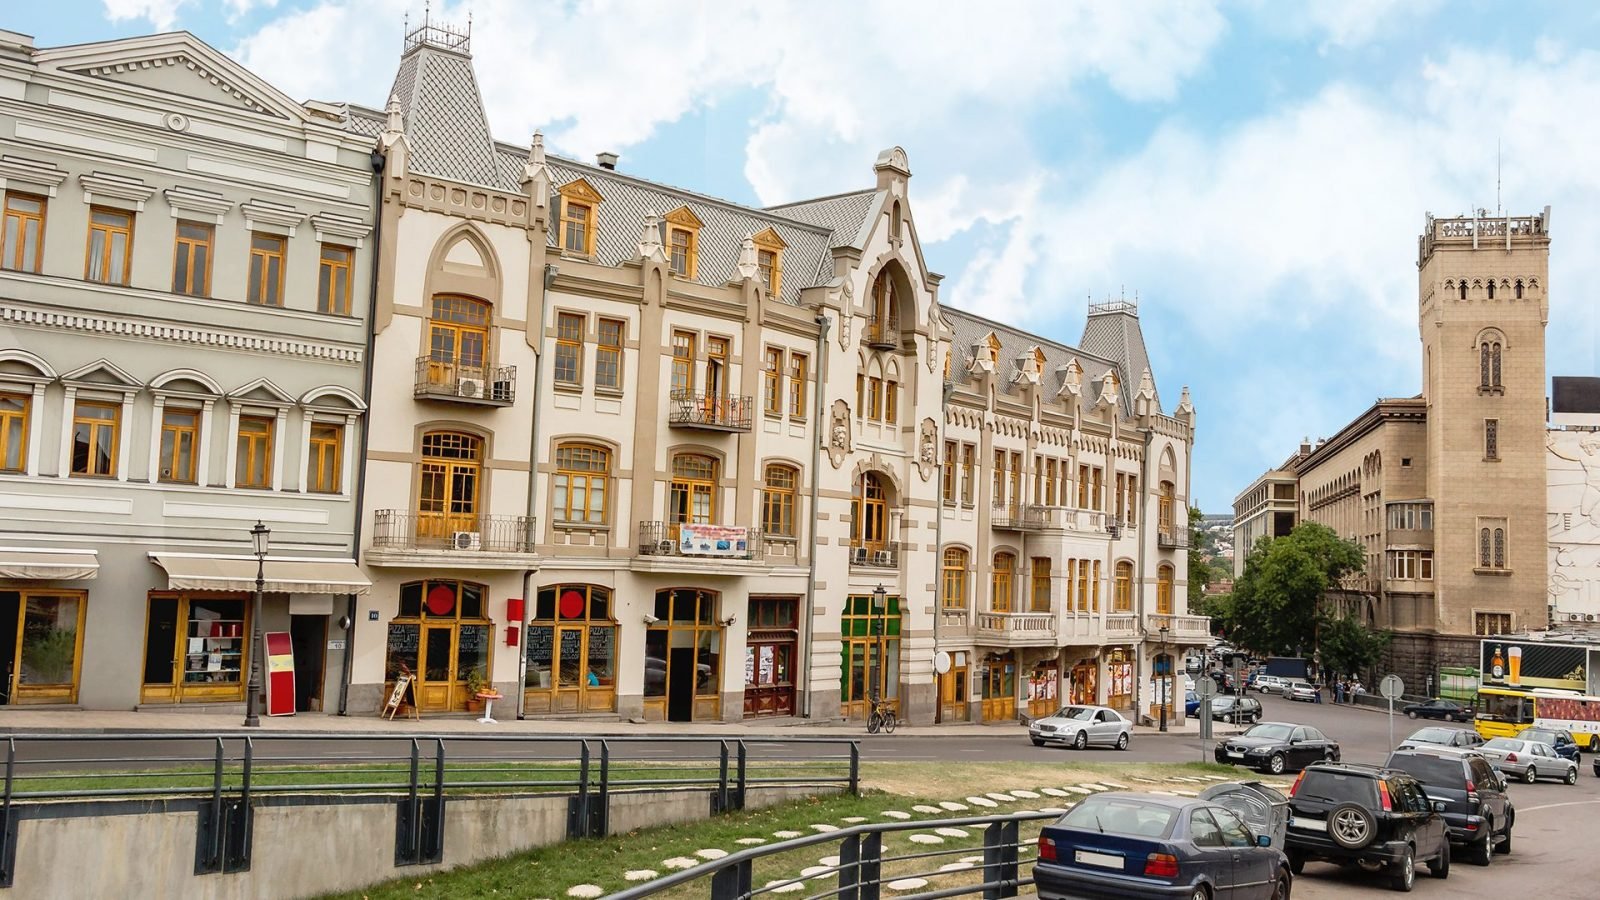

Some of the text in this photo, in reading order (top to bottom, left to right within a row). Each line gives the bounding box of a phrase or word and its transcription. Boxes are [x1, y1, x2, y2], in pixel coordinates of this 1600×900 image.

[389, 625, 405, 634] PIZZA
[460, 626, 475, 634] PIZZA
[590, 627, 603, 635] PIZZA
[561, 631, 576, 640] PIZZA
